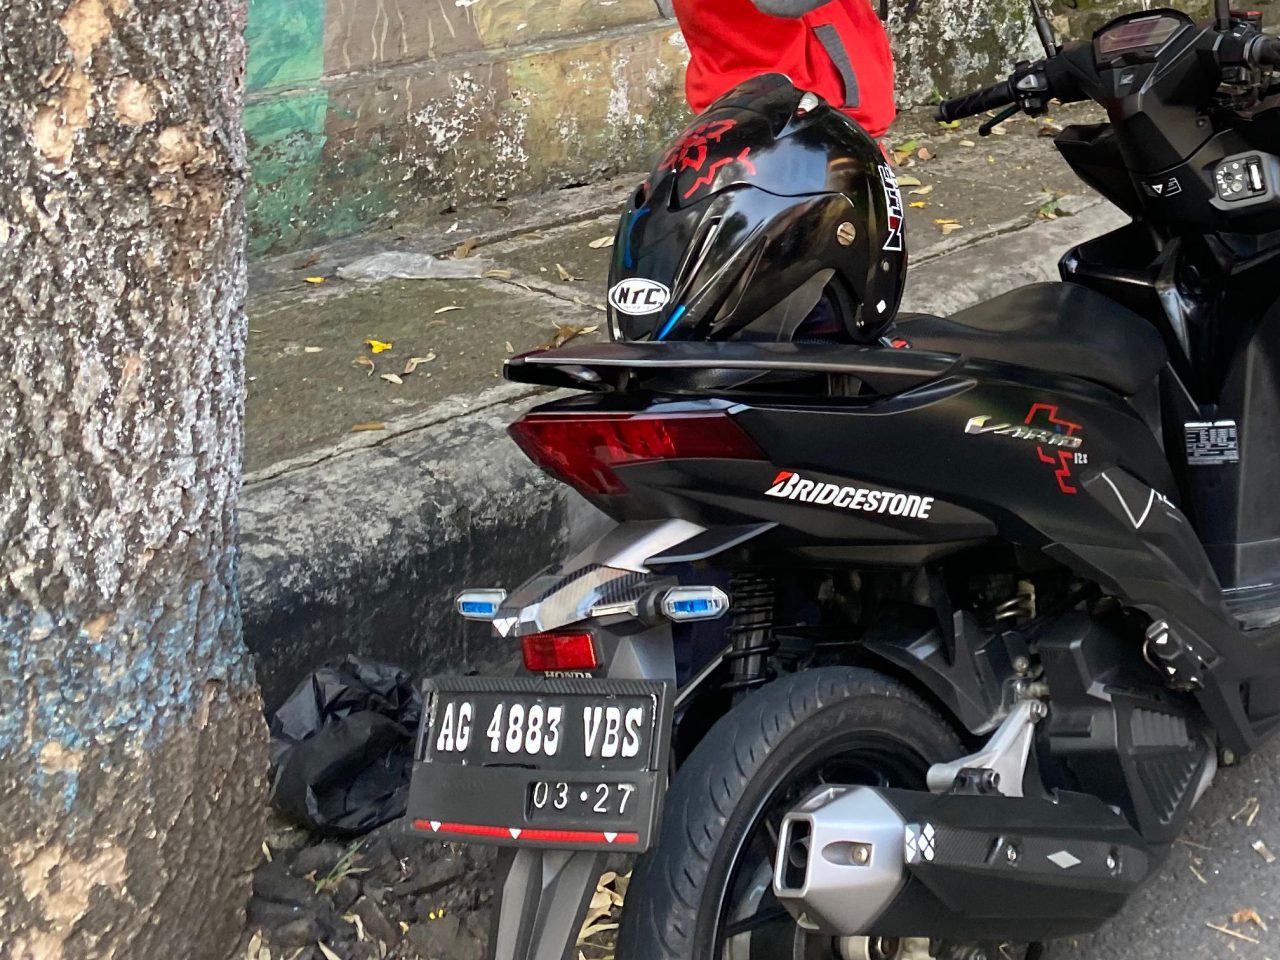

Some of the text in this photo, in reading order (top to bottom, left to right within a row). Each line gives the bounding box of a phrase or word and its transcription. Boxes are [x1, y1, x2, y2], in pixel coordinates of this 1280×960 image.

[617, 287, 662, 305] NTC
[764, 471, 935, 519] BRIDGESTONE
[436, 701, 643, 758] AG 4883 VBS
